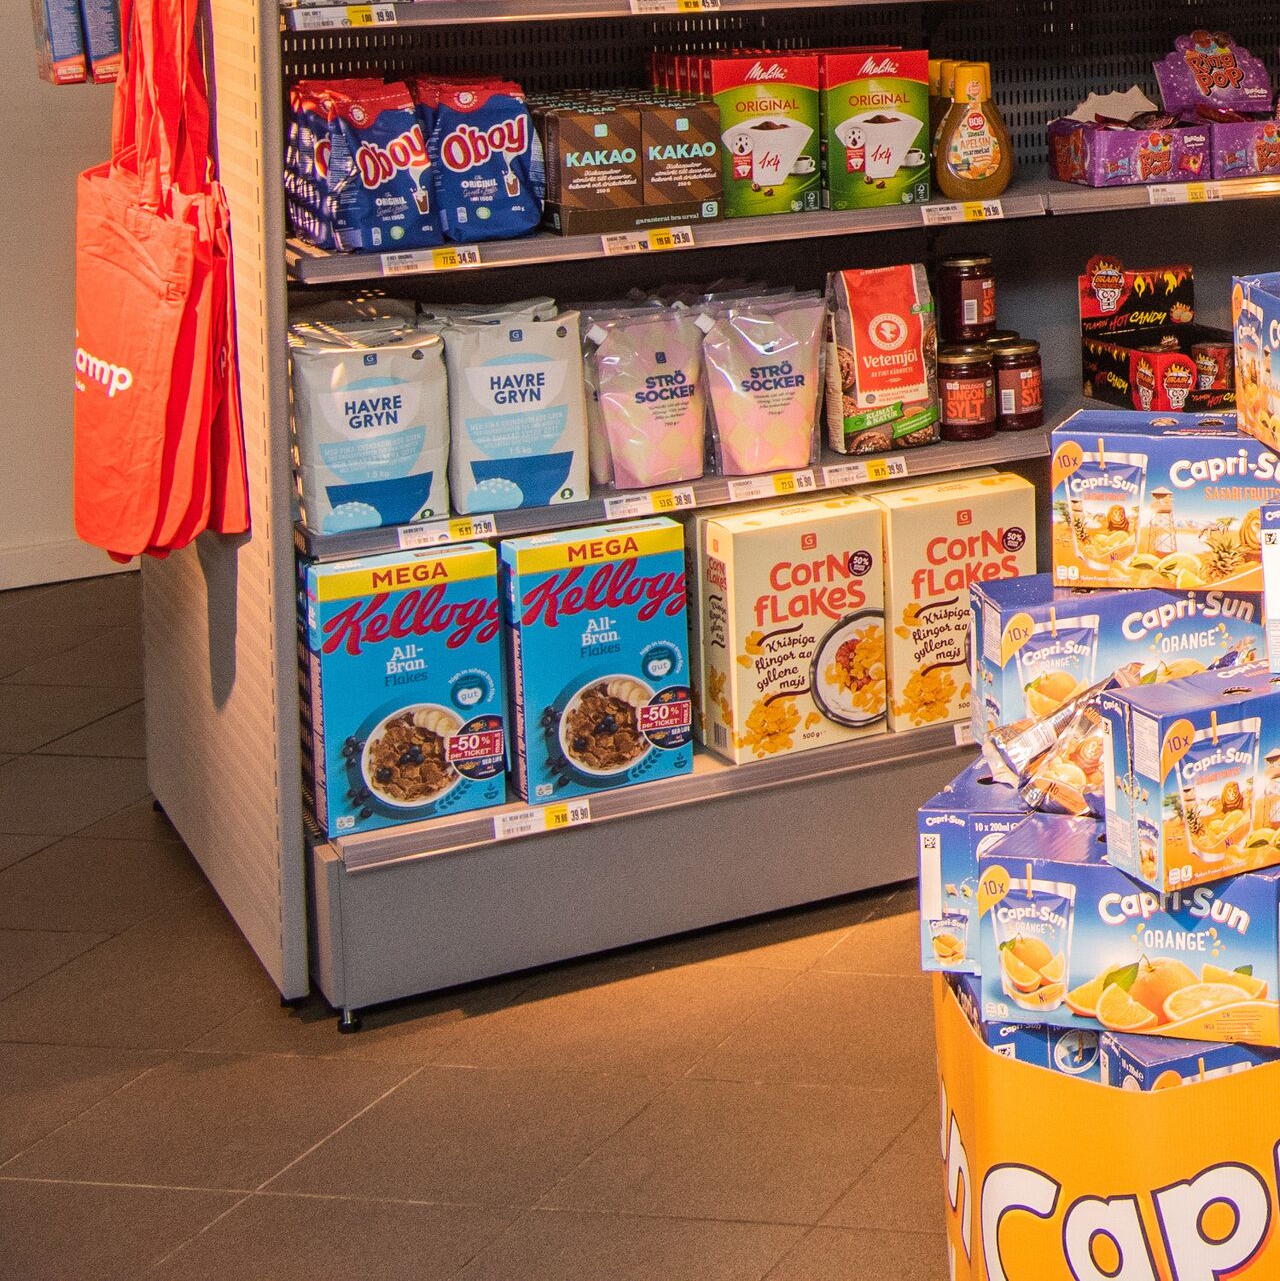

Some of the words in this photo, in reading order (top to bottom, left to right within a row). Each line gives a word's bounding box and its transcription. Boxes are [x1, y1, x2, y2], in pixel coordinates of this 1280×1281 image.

[745, 61, 787, 81] Melitta
[858, 56, 899, 76] Melitta
[735, 98, 800, 112] ORIGINAL
[848, 92, 910, 107] ORIGINAL
[968, 117, 984, 127] BOB
[441, 114, 528, 172] O'boy
[649, 142, 716, 160] KAKAO
[960, 137, 992, 149] APELSIN
[357, 124, 431, 189] O'boy
[566, 148, 636, 167] KAKAO
[1129, 311, 1166, 325] CANDY
[863, 350, 918, 369] Vetemjöl
[750, 361, 792, 379] STRÖ
[490, 372, 545, 390] HAVRE
[645, 370, 687, 390] STRÖ
[741, 374, 805, 392] SOCKER
[494, 387, 541, 404] GRYN
[635, 383, 695, 404] SOCKER
[947, 389, 986, 402] LINGON
[344, 395, 402, 416] HAVRE
[947, 400, 983, 419] SYLT
[349, 411, 399, 429] GRYN
[887, 460, 904, 474] 39.90
[1057, 454, 1078, 470] 10x
[1071, 473, 1139, 495] Capri-Sun
[473, 522, 493, 534] 23.90
[567, 538, 639, 562] MEGA
[371, 562, 448, 589] MEGA
[1121, 591, 1255, 641] Capri-Sun
[585, 619, 616, 632] All-
[1161, 629, 1217, 654] ORANGE
[390, 646, 424, 661] All-
[580, 643, 621, 659] Flakes
[384, 671, 428, 686] Flakes
[1167, 734, 1190, 756] 10x
[1183, 748, 1253, 779] Capri-Sun
[571, 807, 589, 821] 39.90
[996, 904, 1067, 931] Capri-Sun
[1097, 885, 1250, 936] Capri-Sun
[1143, 927, 1207, 952] ORANGE
